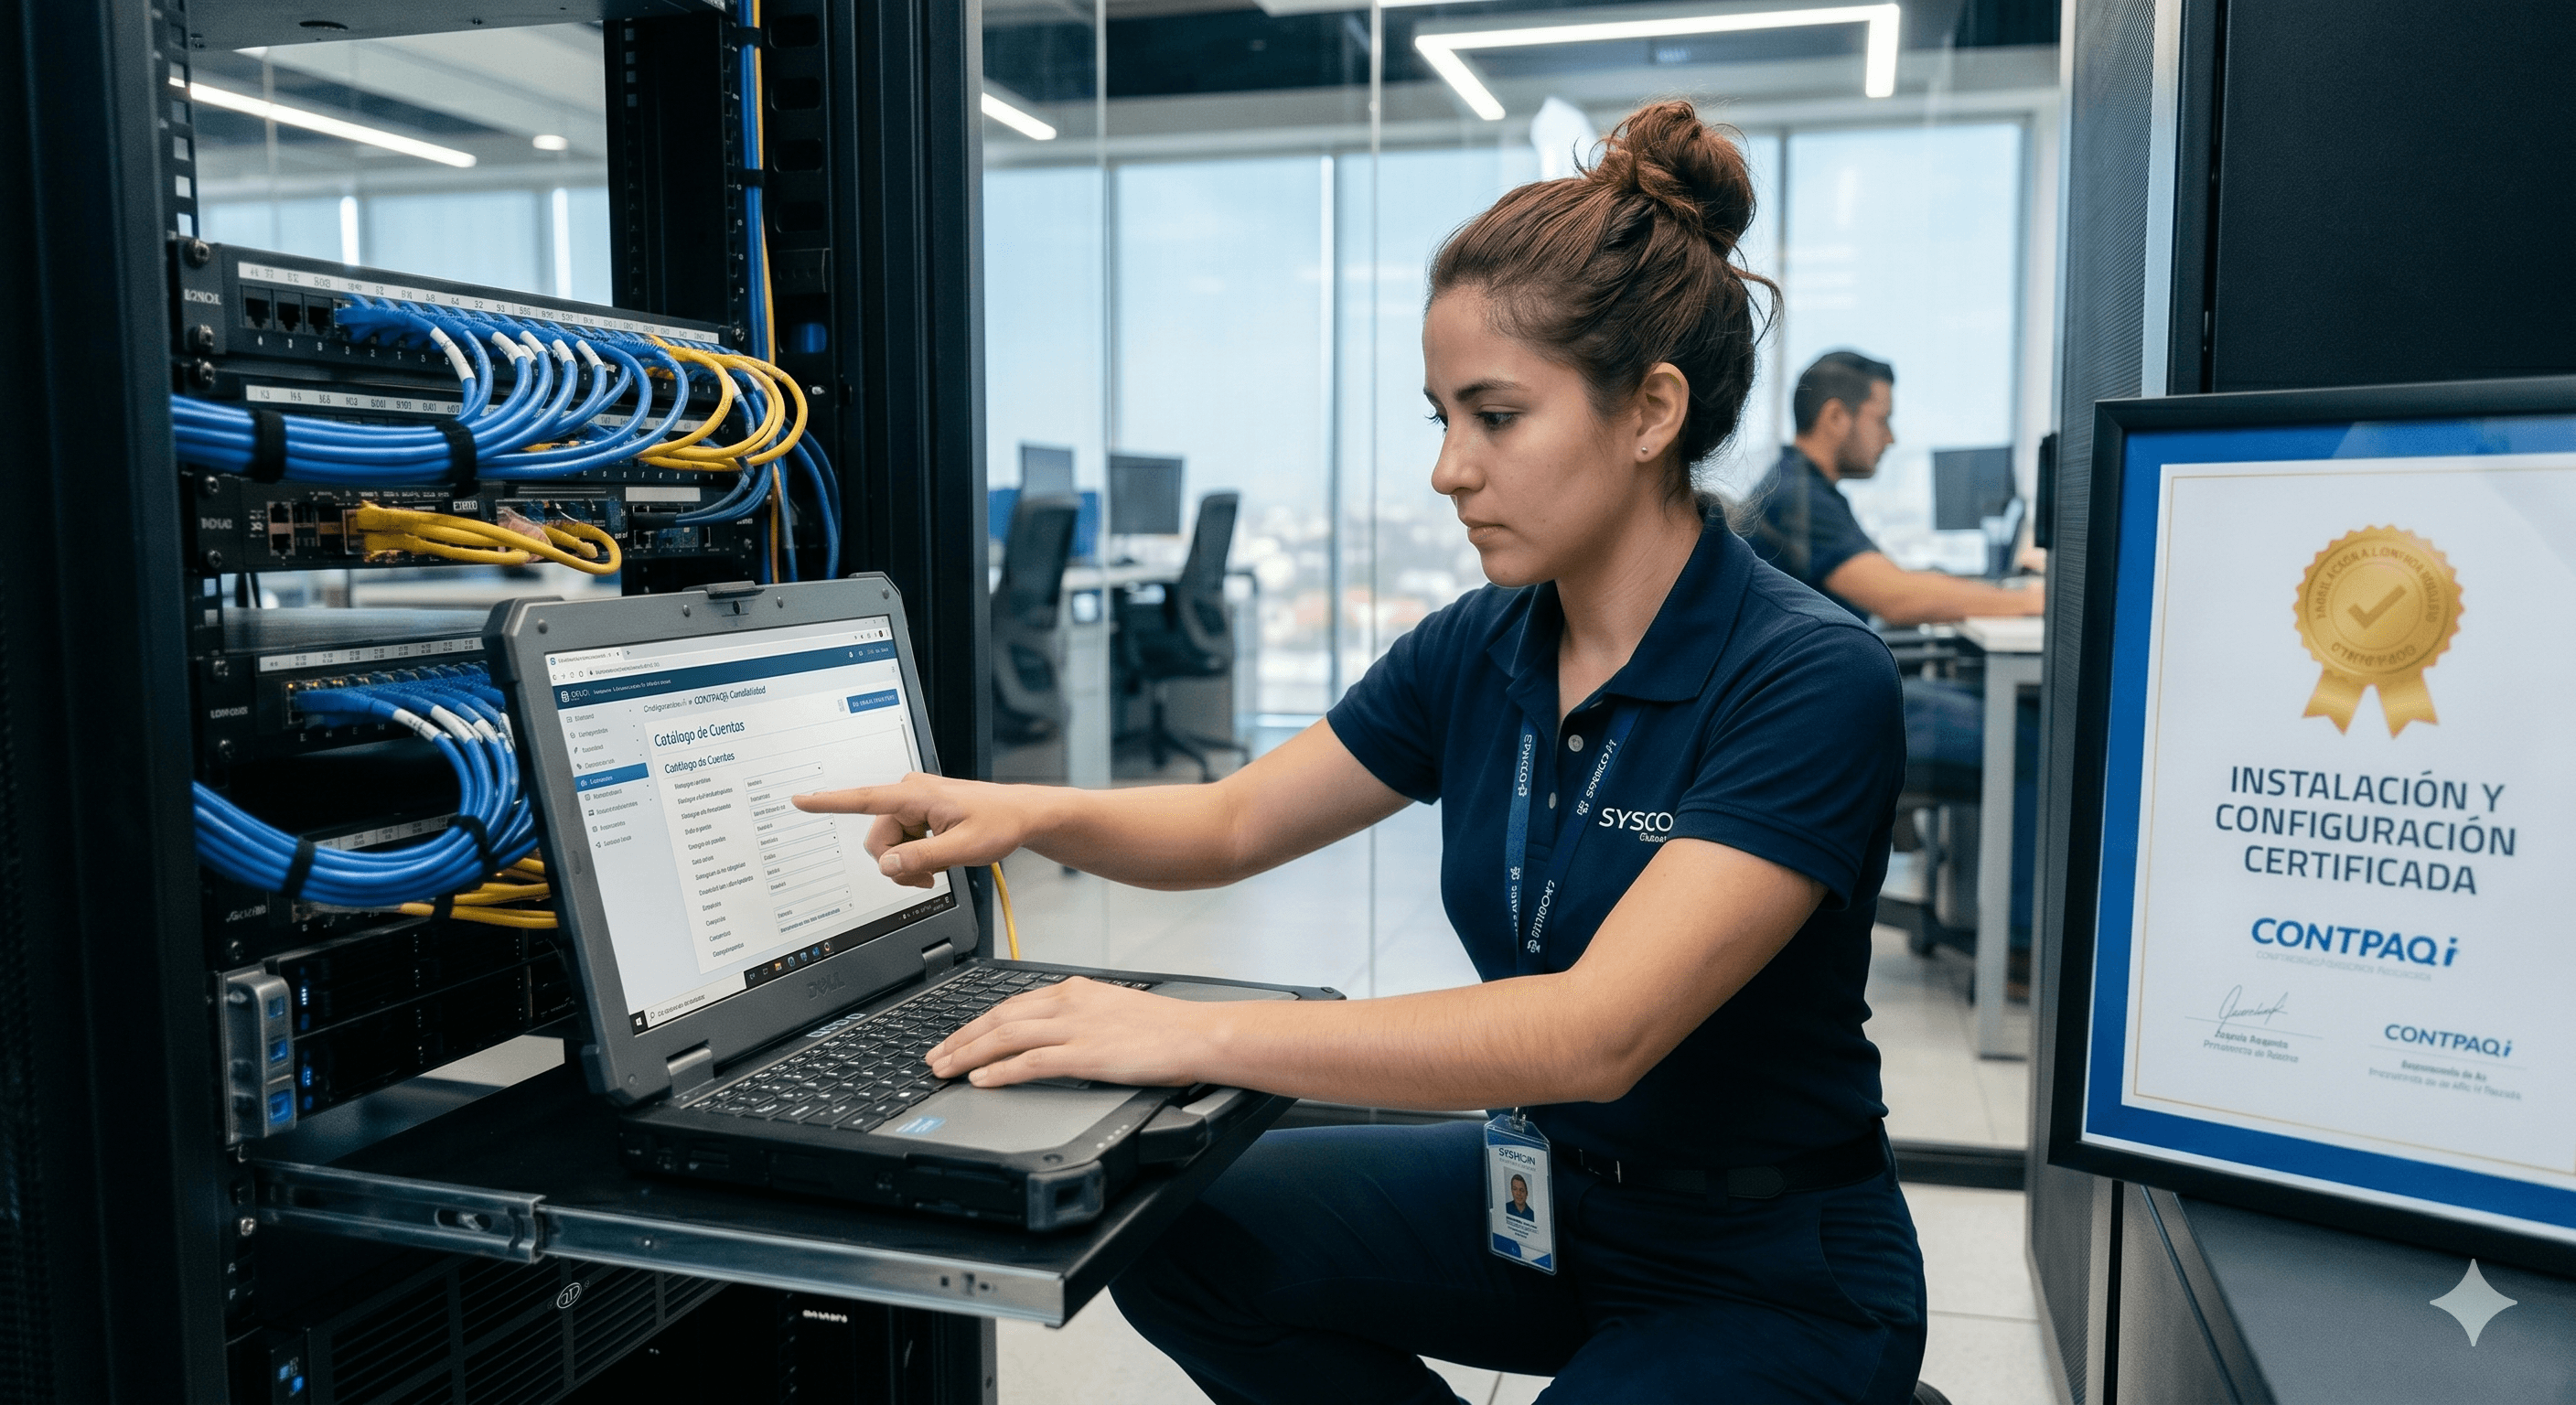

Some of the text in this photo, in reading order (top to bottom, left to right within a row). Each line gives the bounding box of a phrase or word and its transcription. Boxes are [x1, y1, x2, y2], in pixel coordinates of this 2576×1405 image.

[2230, 766, 2506, 813] INSTALACIÓN Y
[1598, 807, 1674, 832] SYSCO
[2215, 803, 2517, 857] CONFIGURACIÓN
[2244, 844, 2477, 896] CERTIFICADA
